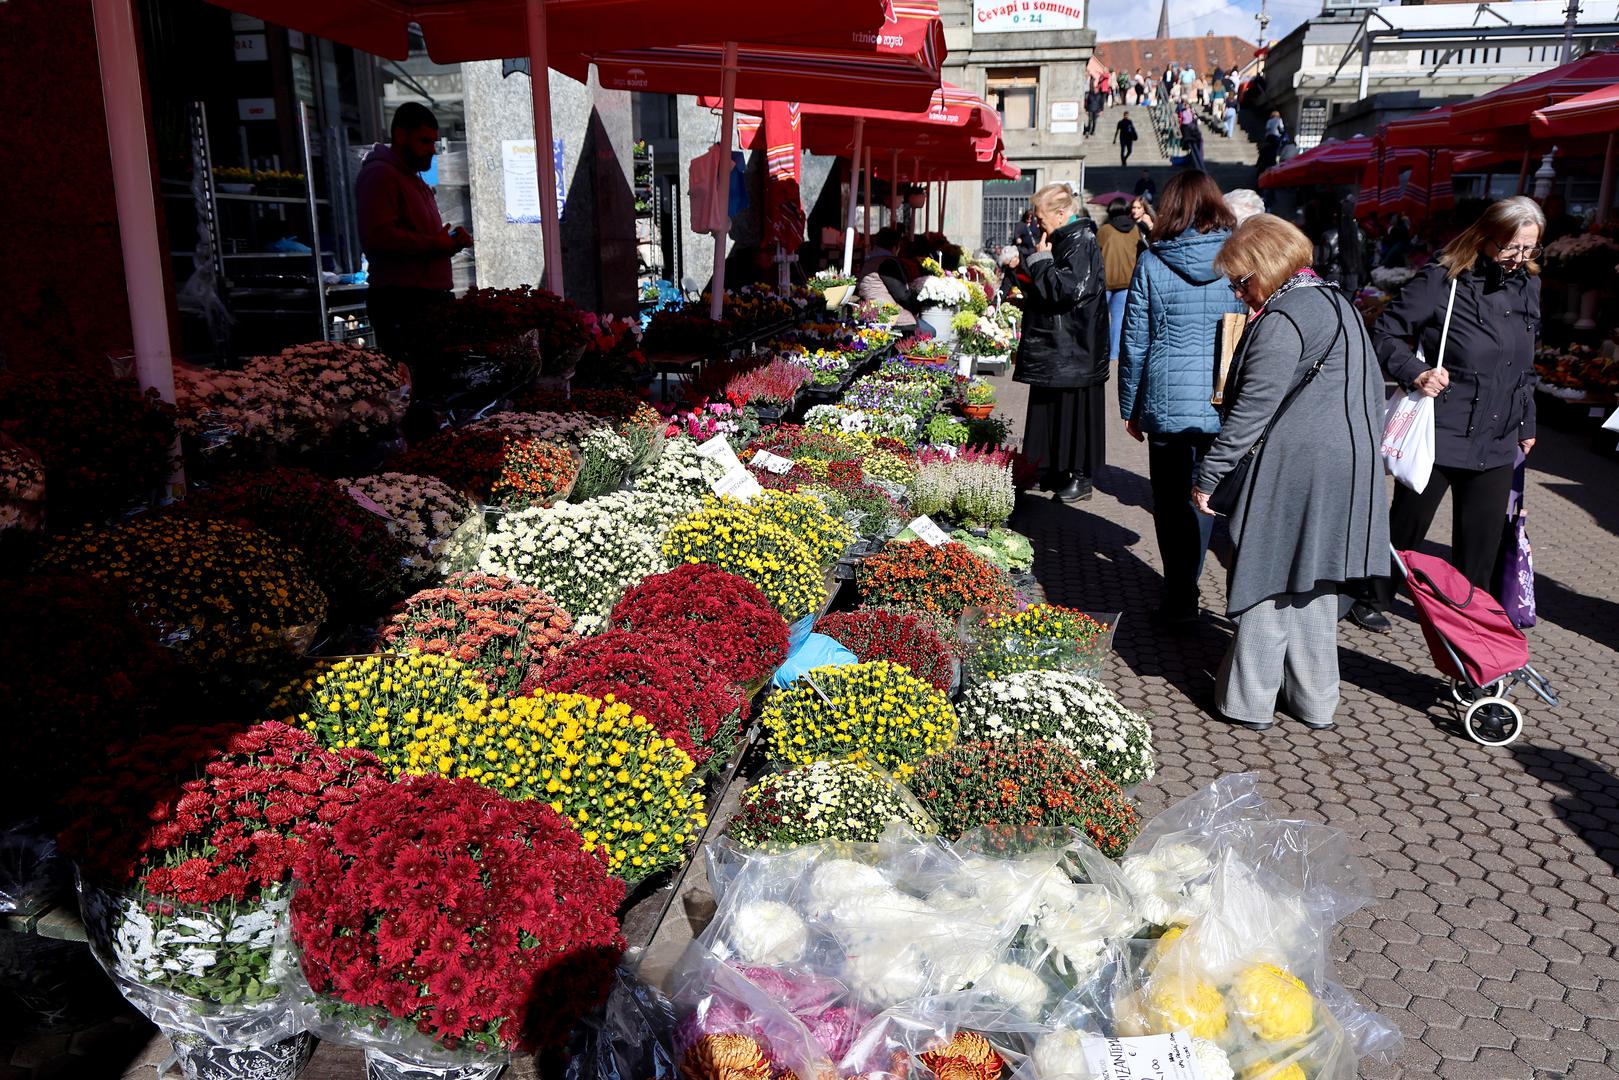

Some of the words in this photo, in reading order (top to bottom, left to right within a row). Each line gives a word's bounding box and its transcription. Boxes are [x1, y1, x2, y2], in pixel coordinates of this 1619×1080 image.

[977, 0, 1018, 23] Čevapi
[1022, 2, 1030, 11] u
[1034, 1, 1081, 19] somunu
[1013, 14, 1020, 24] 0
[1029, 14, 1042, 24] 24
